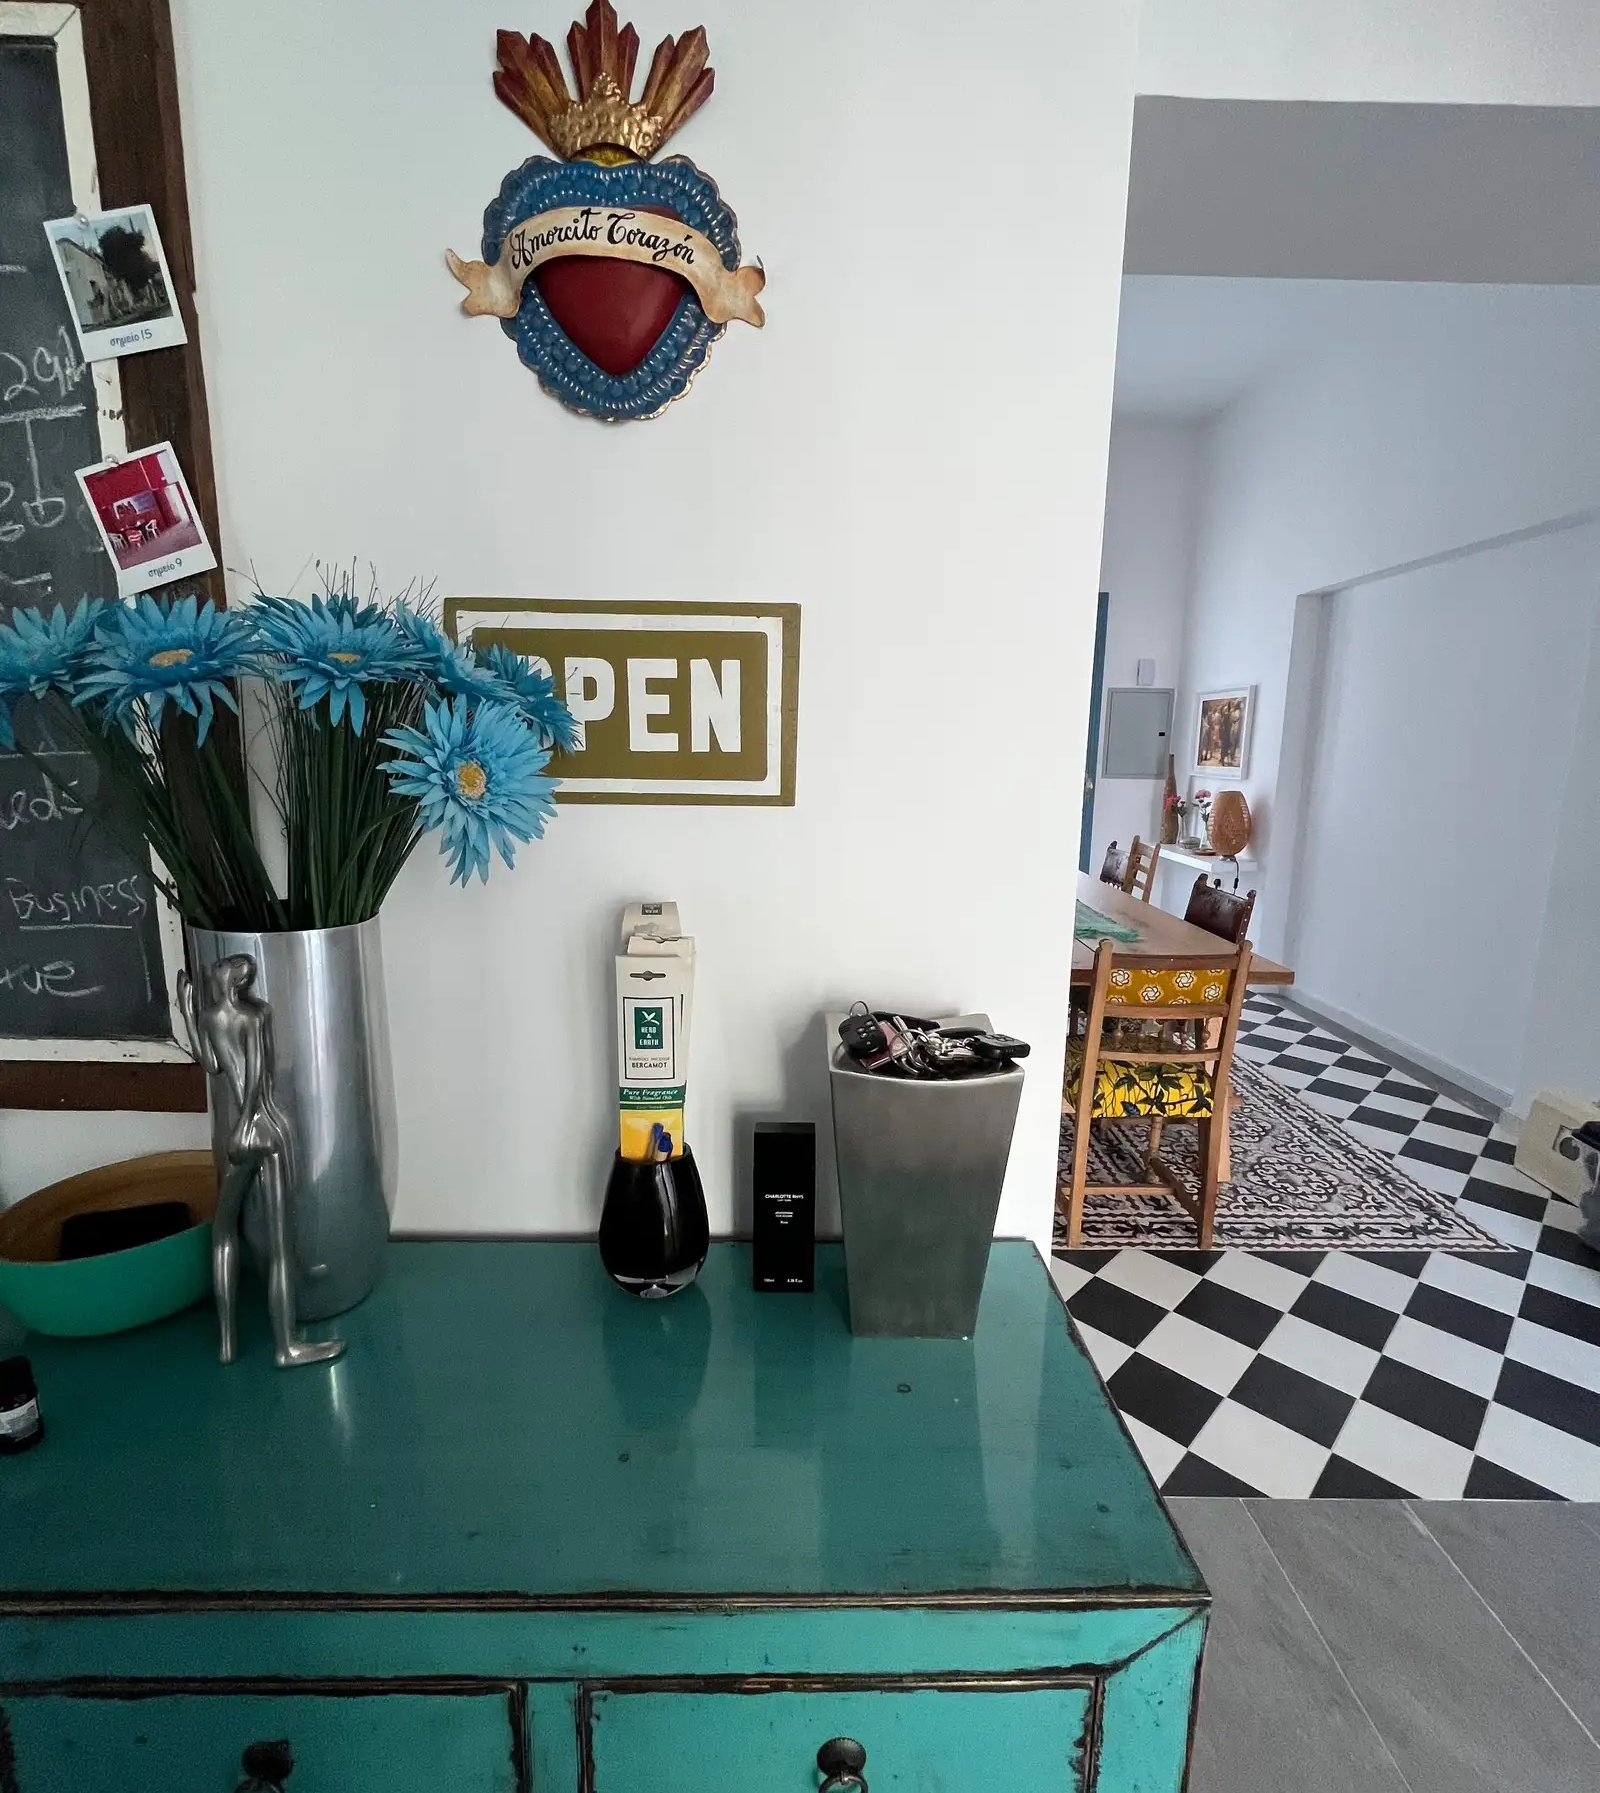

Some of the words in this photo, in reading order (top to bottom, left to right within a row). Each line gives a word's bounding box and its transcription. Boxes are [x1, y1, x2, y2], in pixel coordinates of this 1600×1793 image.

[510, 208, 602, 269] Amorcito
[607, 213, 695, 265] Corazón
[175, 557, 182, 567] 9
[516, 655, 742, 753] PEN
[623, 1088, 640, 1096] Pure
[642, 1089, 678, 1097] Fragrance
